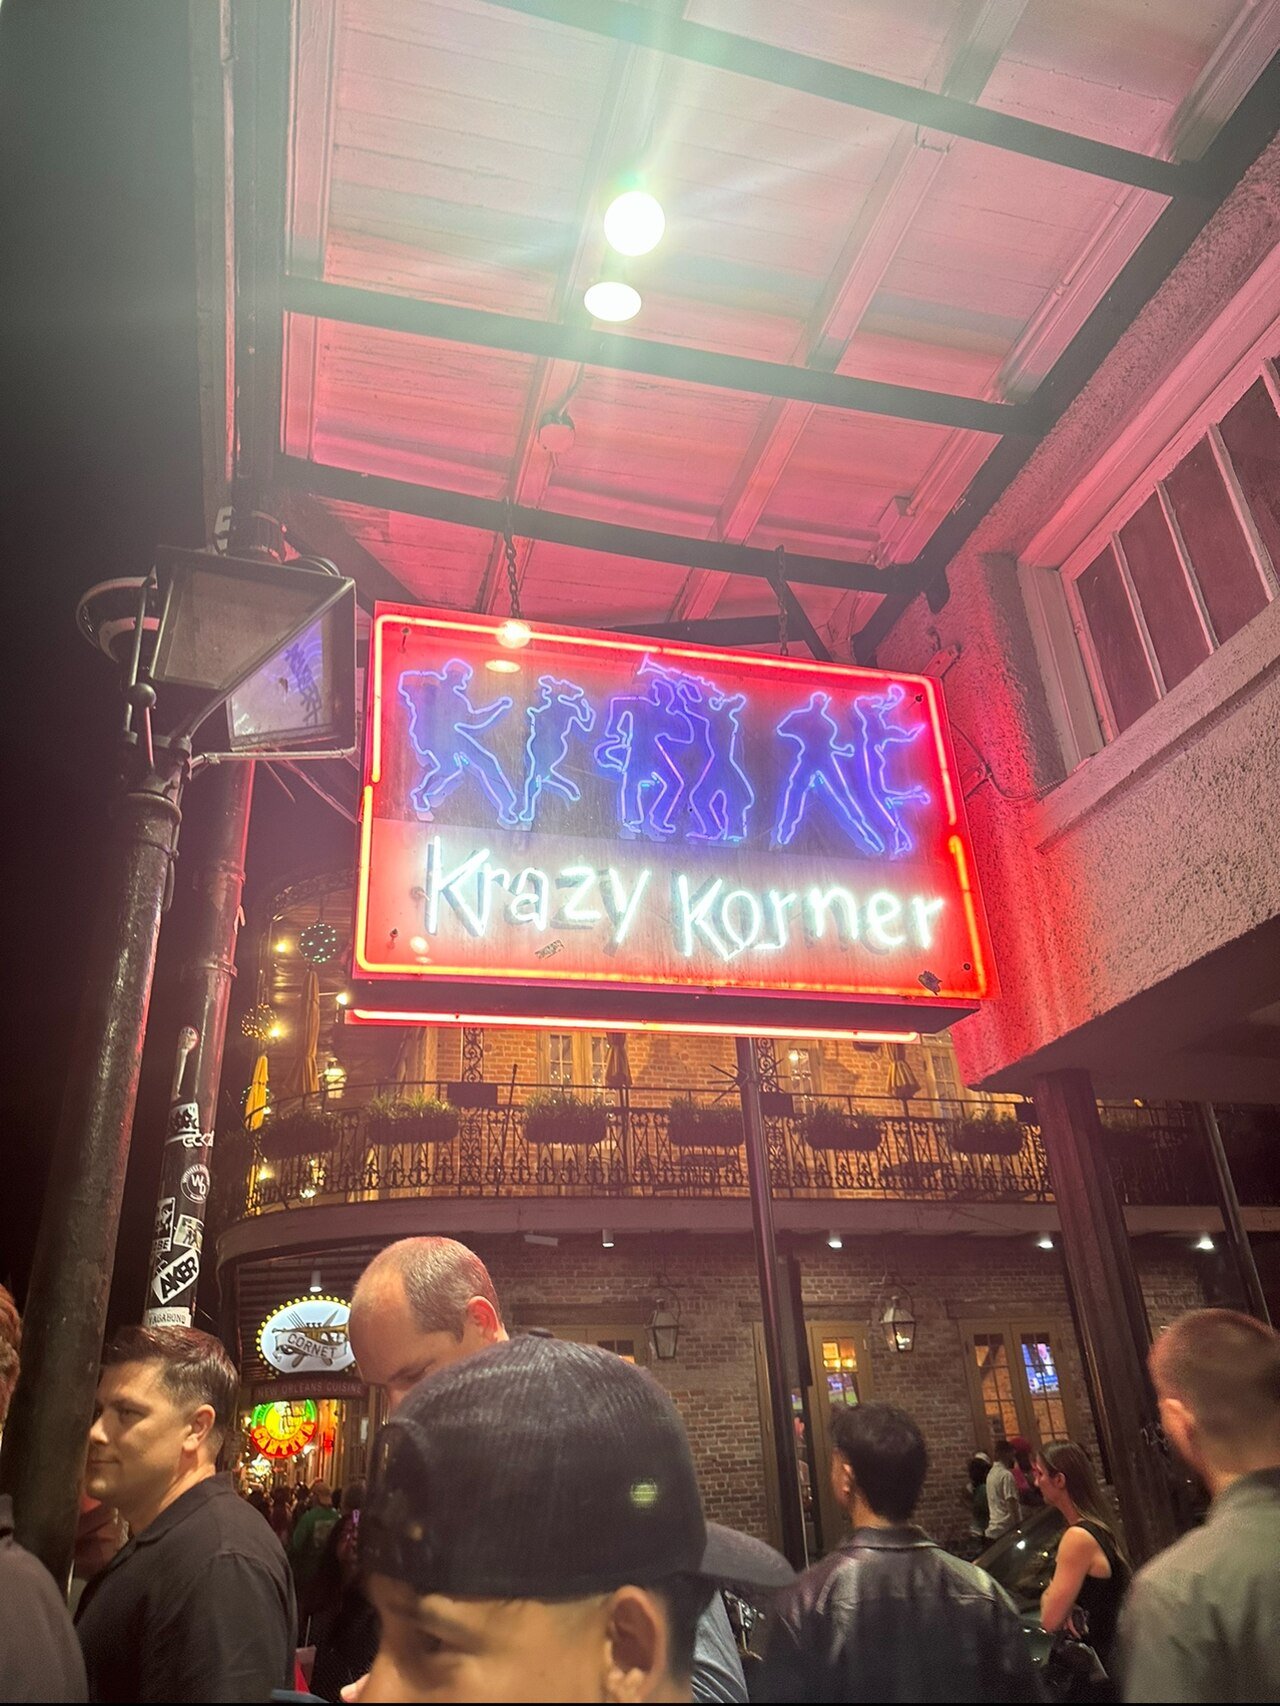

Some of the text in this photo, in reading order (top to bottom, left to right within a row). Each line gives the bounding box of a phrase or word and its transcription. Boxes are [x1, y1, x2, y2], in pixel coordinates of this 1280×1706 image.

[426, 835, 945, 962] Krazy Korner
[287, 1333, 338, 1358] CORNET
[258, 1381, 362, 1397] NEW ORLEANS CUISINE
[253, 1422, 316, 1456] CANTINA
